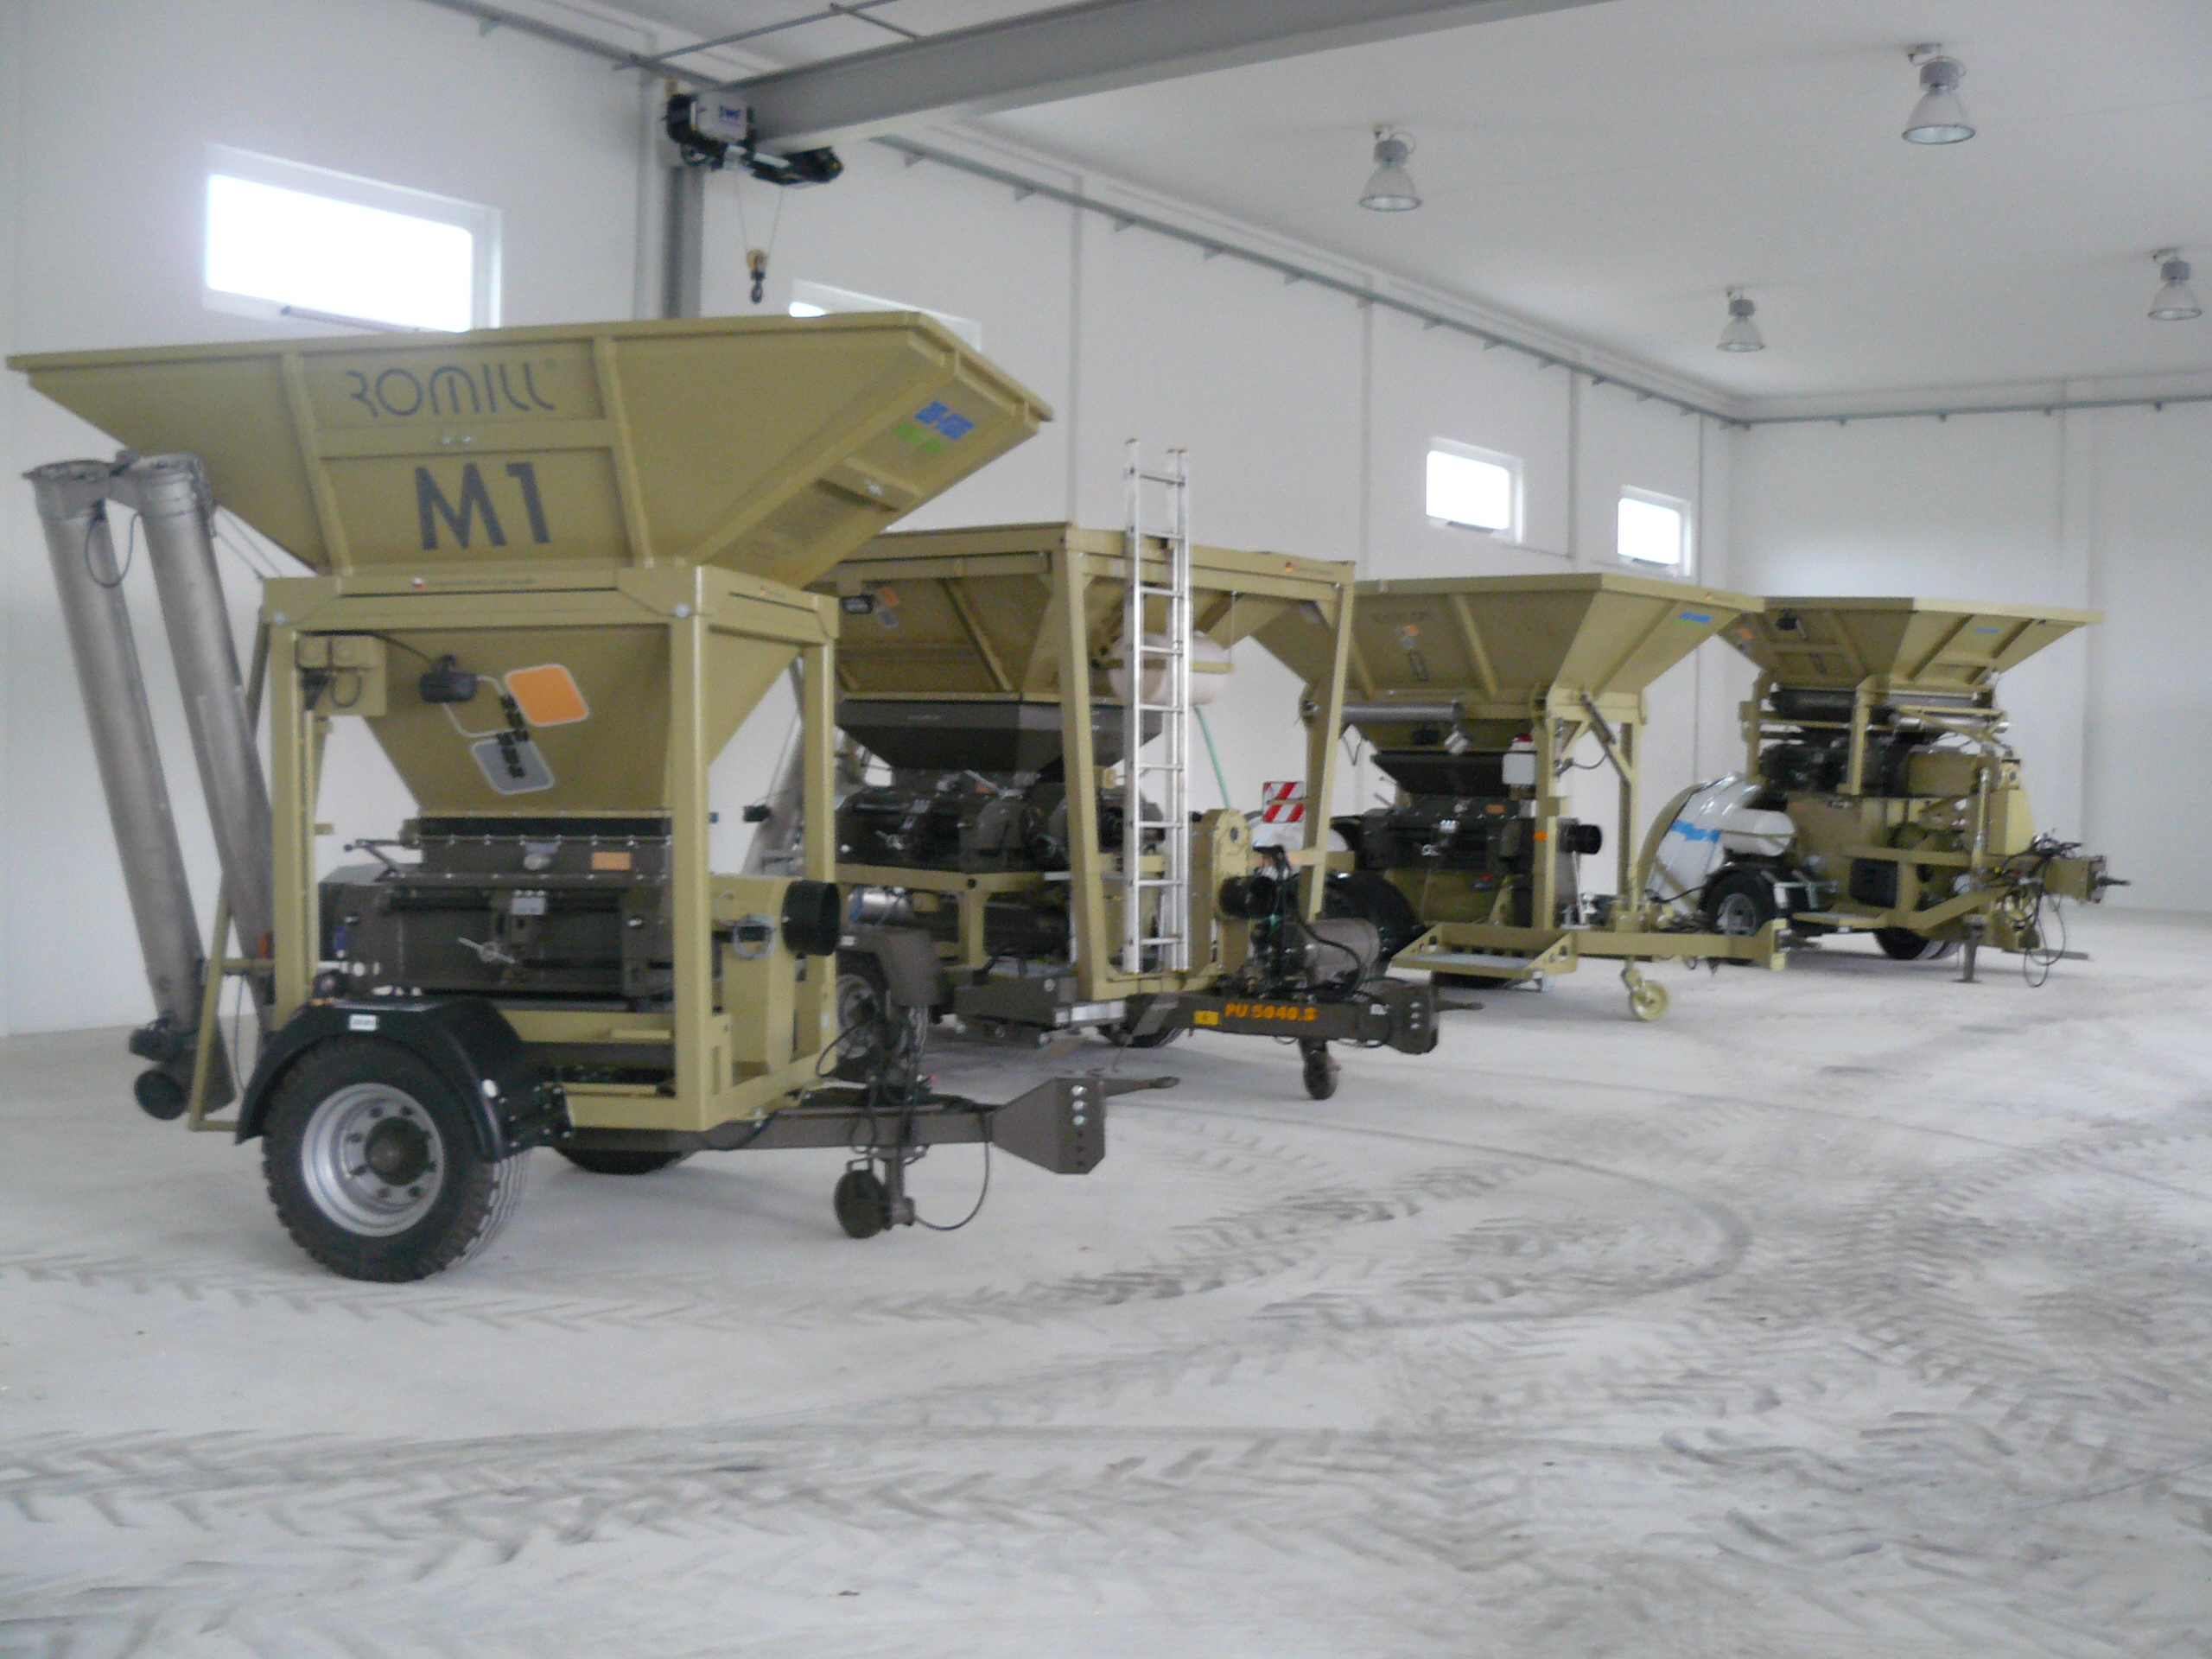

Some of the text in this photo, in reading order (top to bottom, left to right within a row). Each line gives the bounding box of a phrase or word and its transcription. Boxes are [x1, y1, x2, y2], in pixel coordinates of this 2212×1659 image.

[346, 361, 556, 418] ROMILL
[414, 461, 550, 550] M1
[1225, 1002, 1249, 1018] PU
